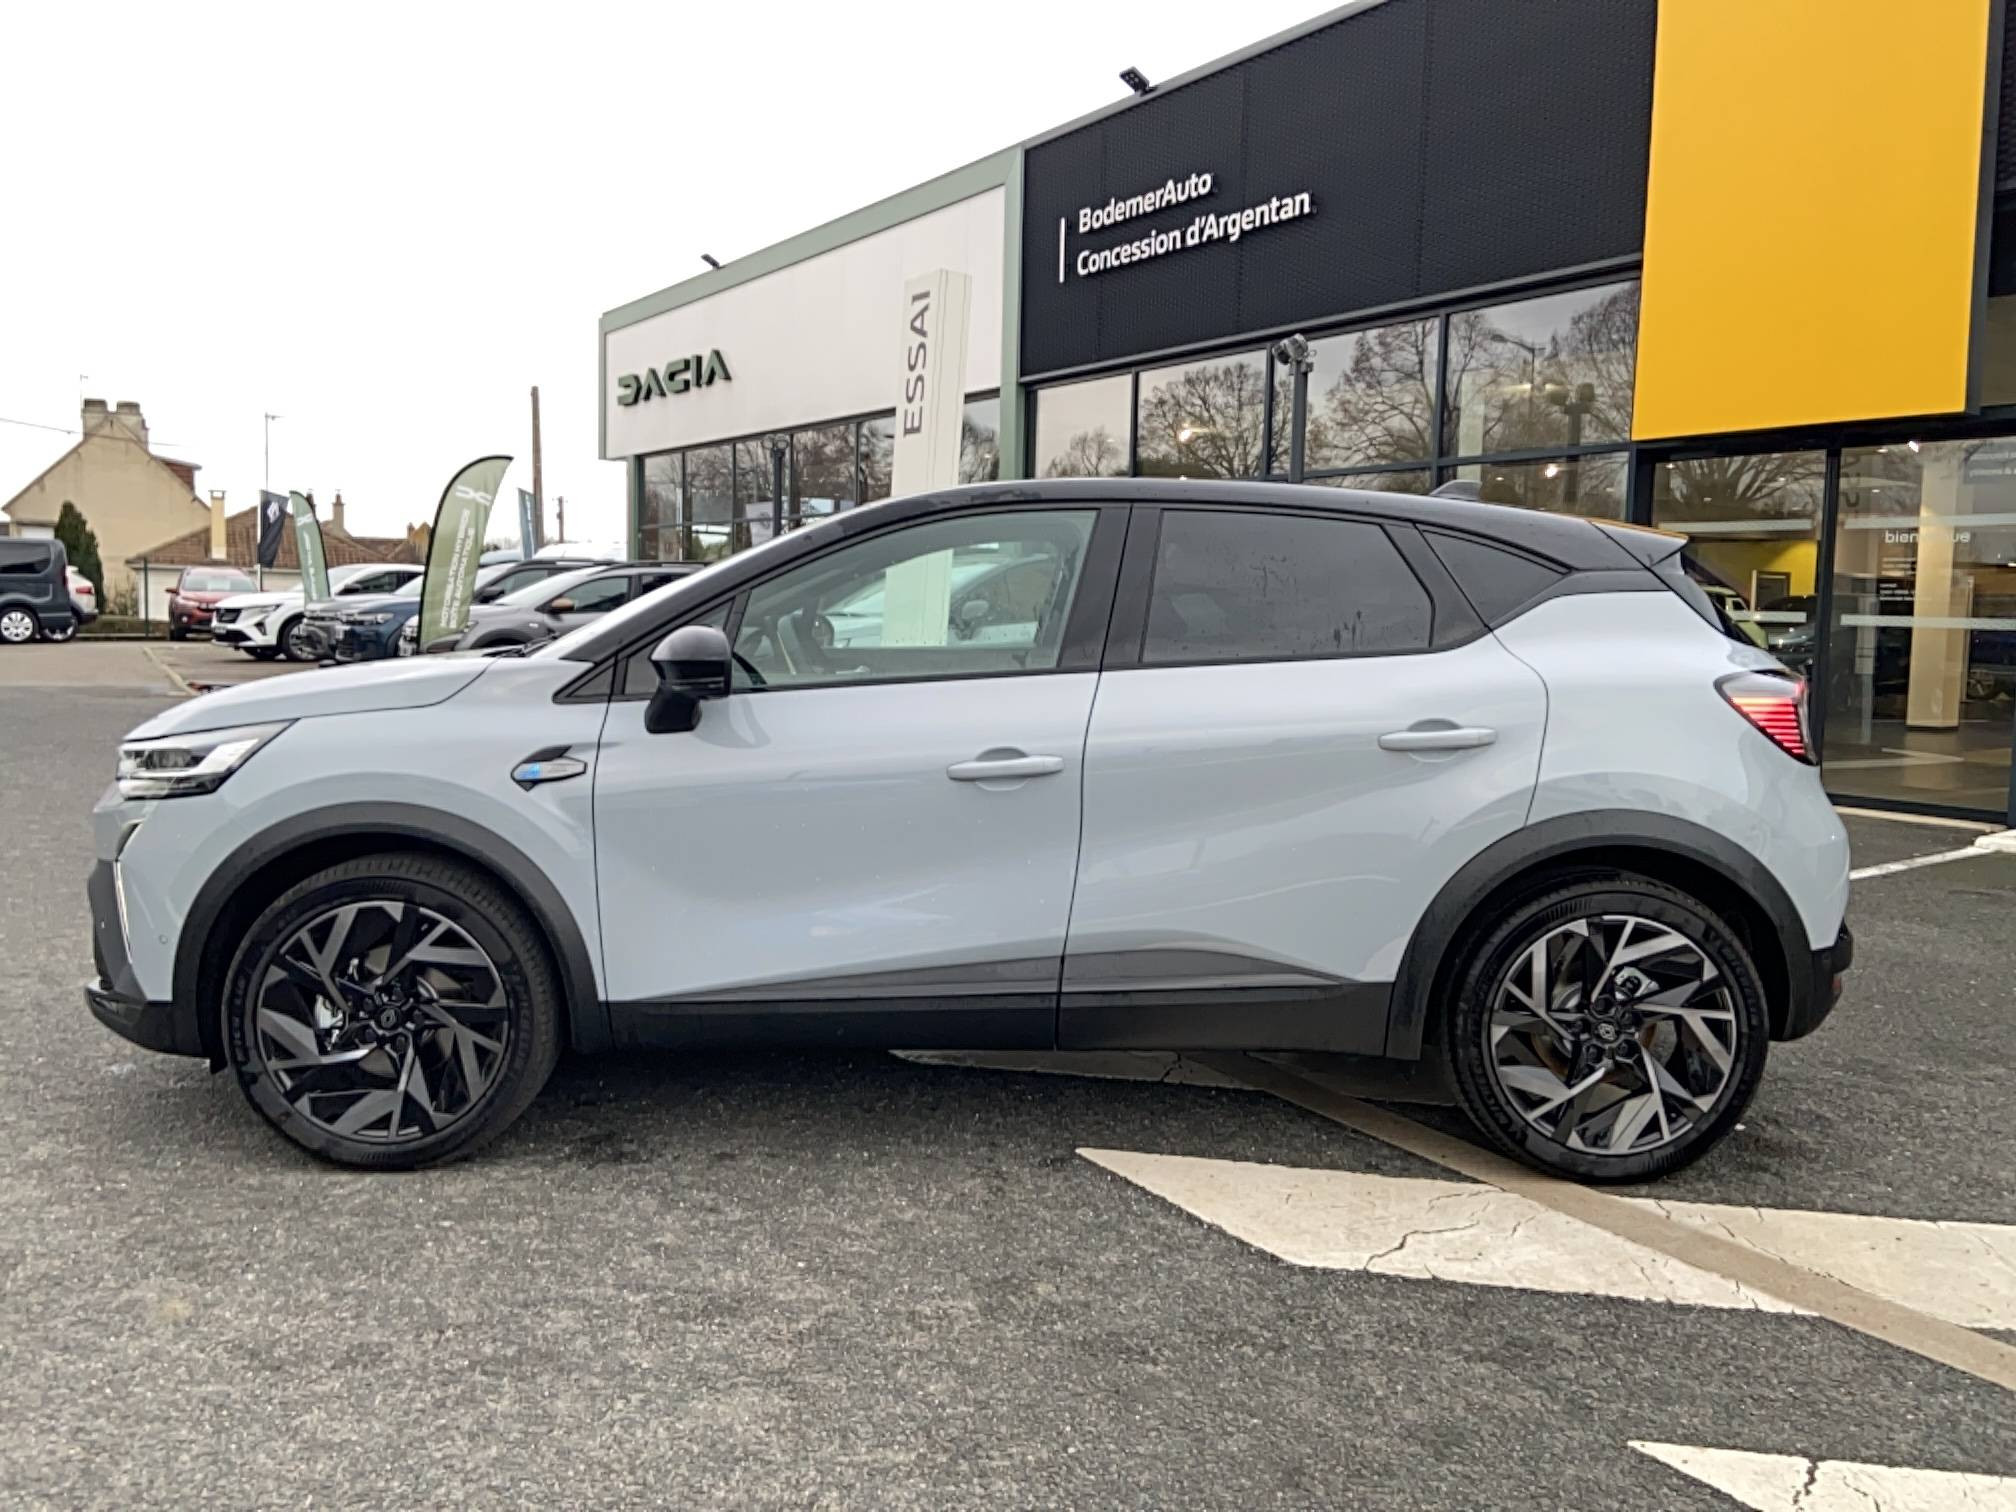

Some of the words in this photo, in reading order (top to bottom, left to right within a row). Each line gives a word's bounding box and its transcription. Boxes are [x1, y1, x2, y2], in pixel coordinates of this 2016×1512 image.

[1078, 172, 1213, 233] BodemerAuto
[1077, 229, 1183, 276] Concession
[1185, 191, 1312, 243] d'Argentan
[616, 349, 732, 408] DACIA
[904, 289, 931, 439] ESSAI
[1885, 530, 1971, 543] bienue
